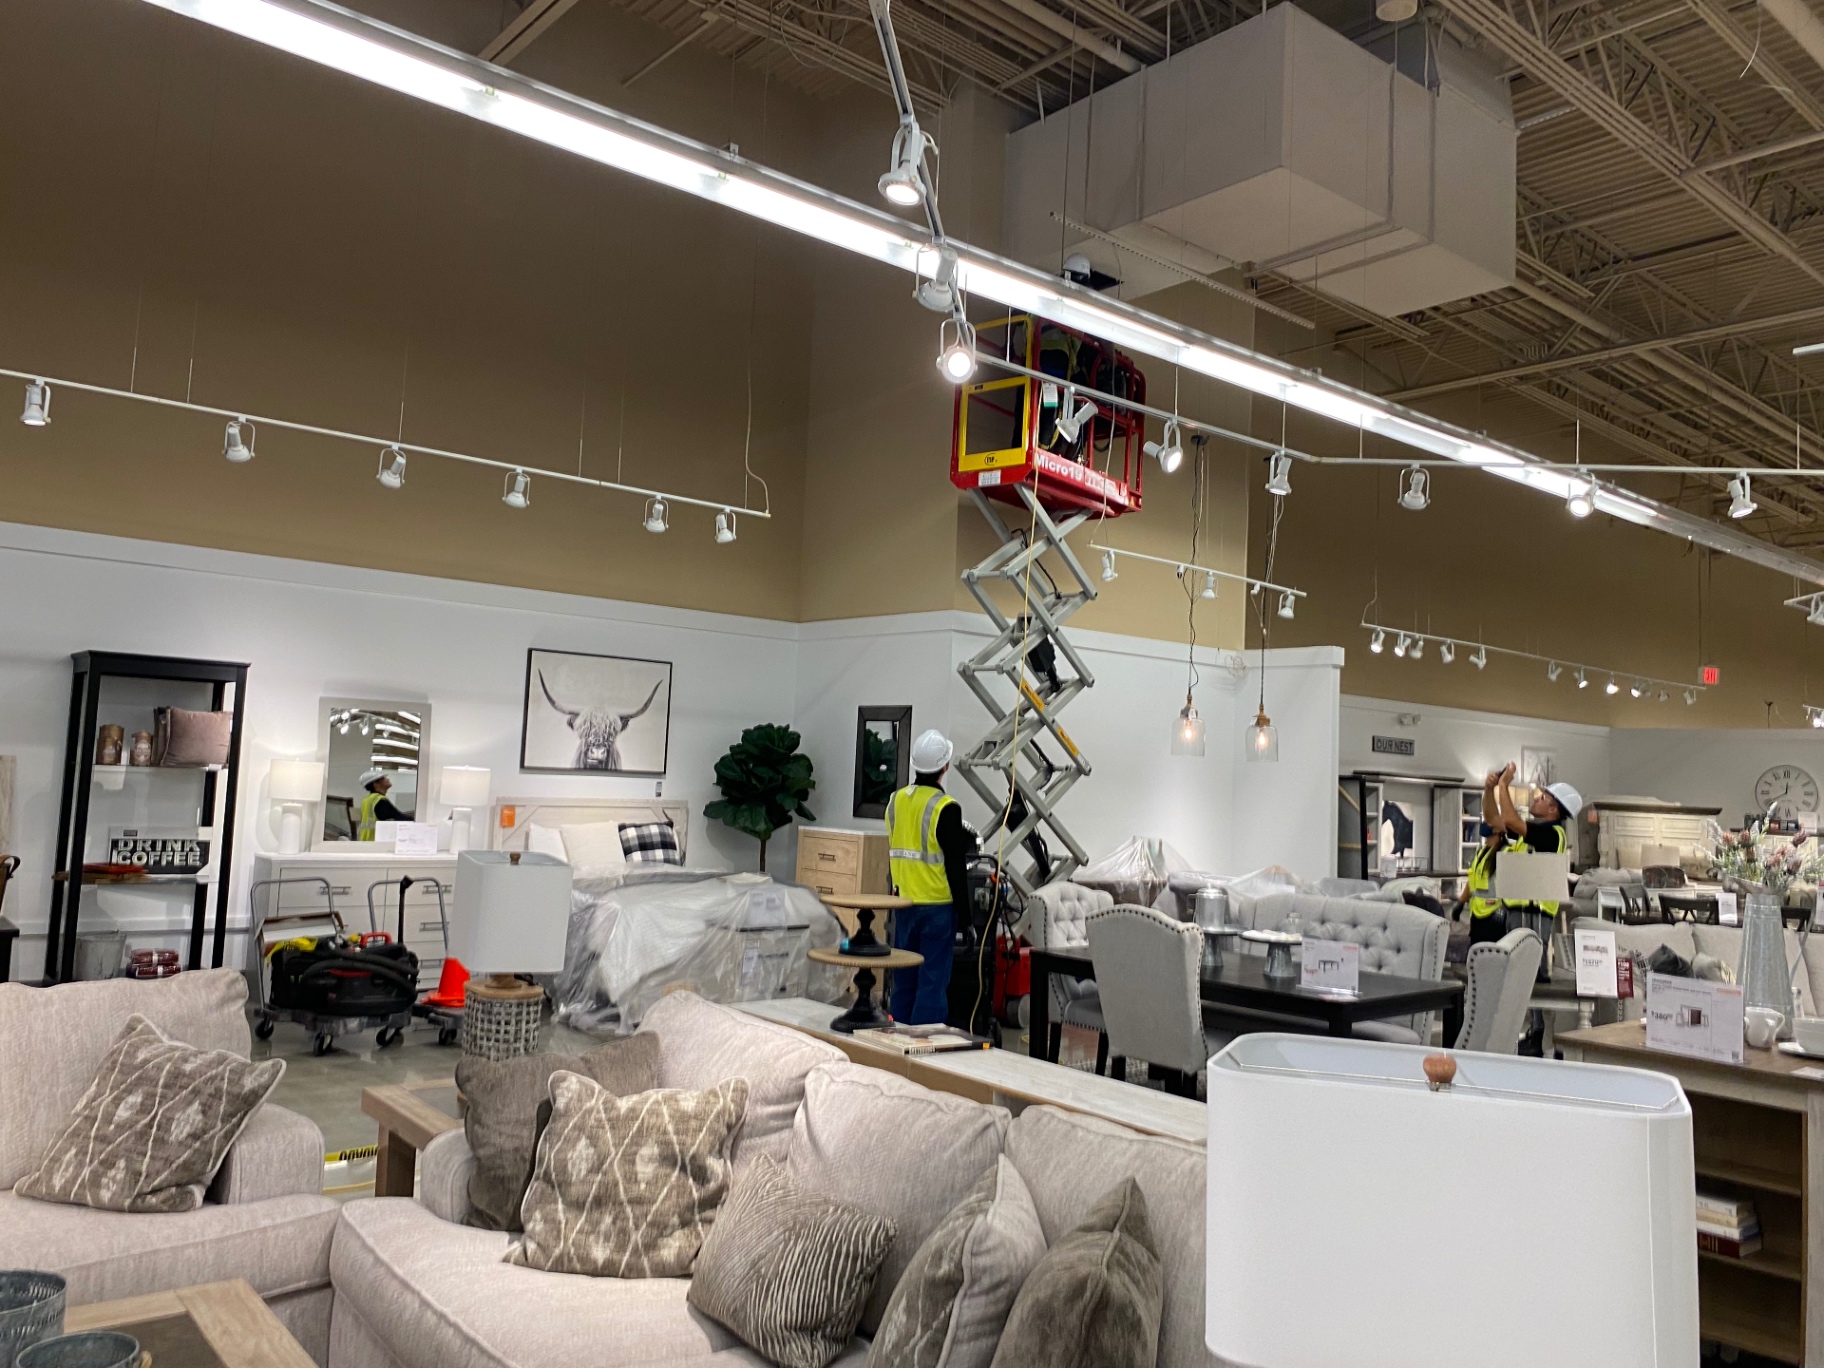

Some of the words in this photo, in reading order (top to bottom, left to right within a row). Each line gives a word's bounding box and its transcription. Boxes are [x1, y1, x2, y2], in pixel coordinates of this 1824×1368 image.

[1036, 453, 1083, 481] Micro19
[1376, 738, 1393, 750] OUR
[1394, 741, 1414, 753] NEST
[118, 839, 200, 852] DRINK
[117, 851, 201, 866] COFFEE
